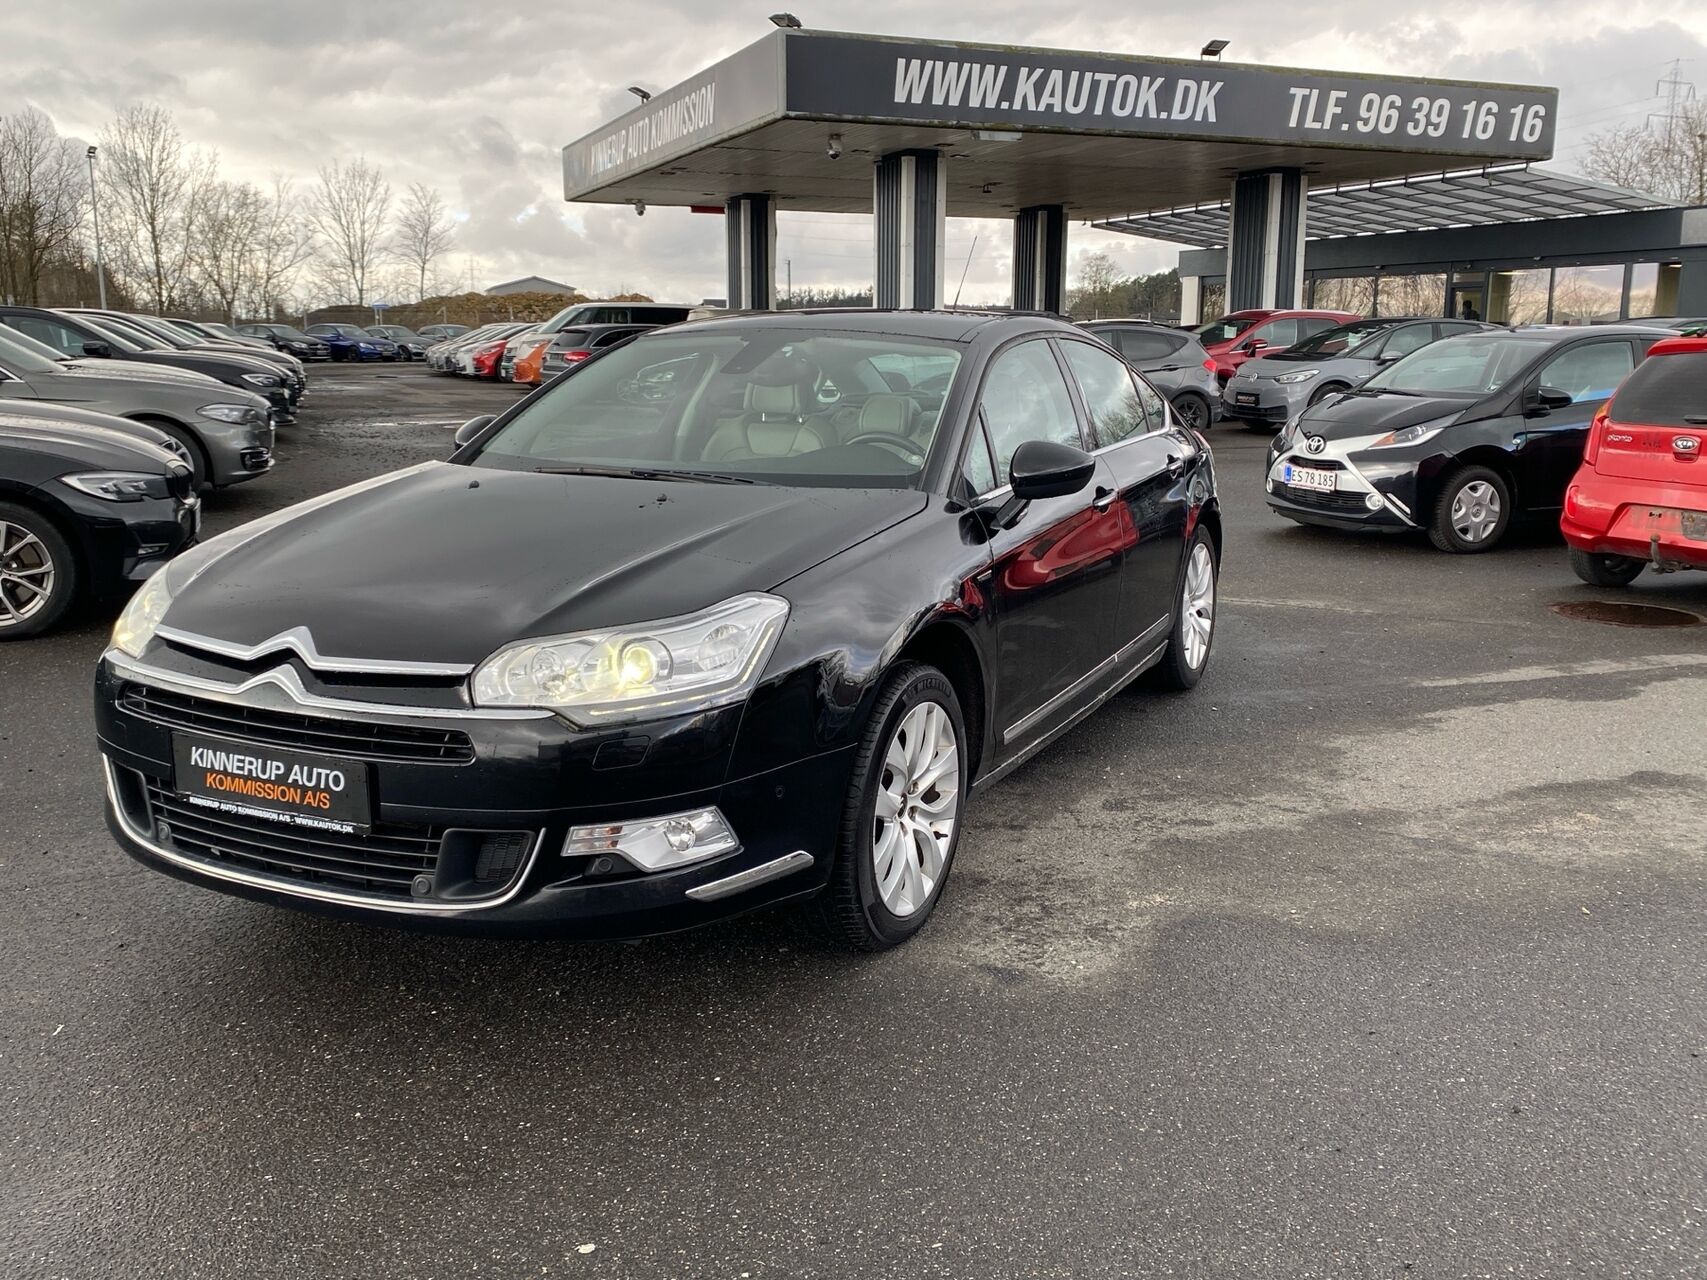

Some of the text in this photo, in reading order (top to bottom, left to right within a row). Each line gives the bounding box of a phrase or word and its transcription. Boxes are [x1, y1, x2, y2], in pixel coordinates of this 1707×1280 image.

[894, 57, 1224, 122] WWW.KAUTOK.DK
[627, 116, 650, 161] AUTO
[650, 82, 716, 150] KOMMISSION
[1288, 87, 1546, 143] TLF. 96 39 16 16
[1292, 470, 1334, 487] ES 78 185
[190, 746, 345, 792] KINNERUP AUTO
[206, 773, 331, 809] KOMMISSION A/S
[189, 796, 220, 810] KINNERUP
[220, 803, 238, 814] AUTO
[238, 805, 279, 822] KOMMISSION
[279, 814, 291, 823] A/S
[295, 816, 354, 834] WWW.KAUTOK.DK
